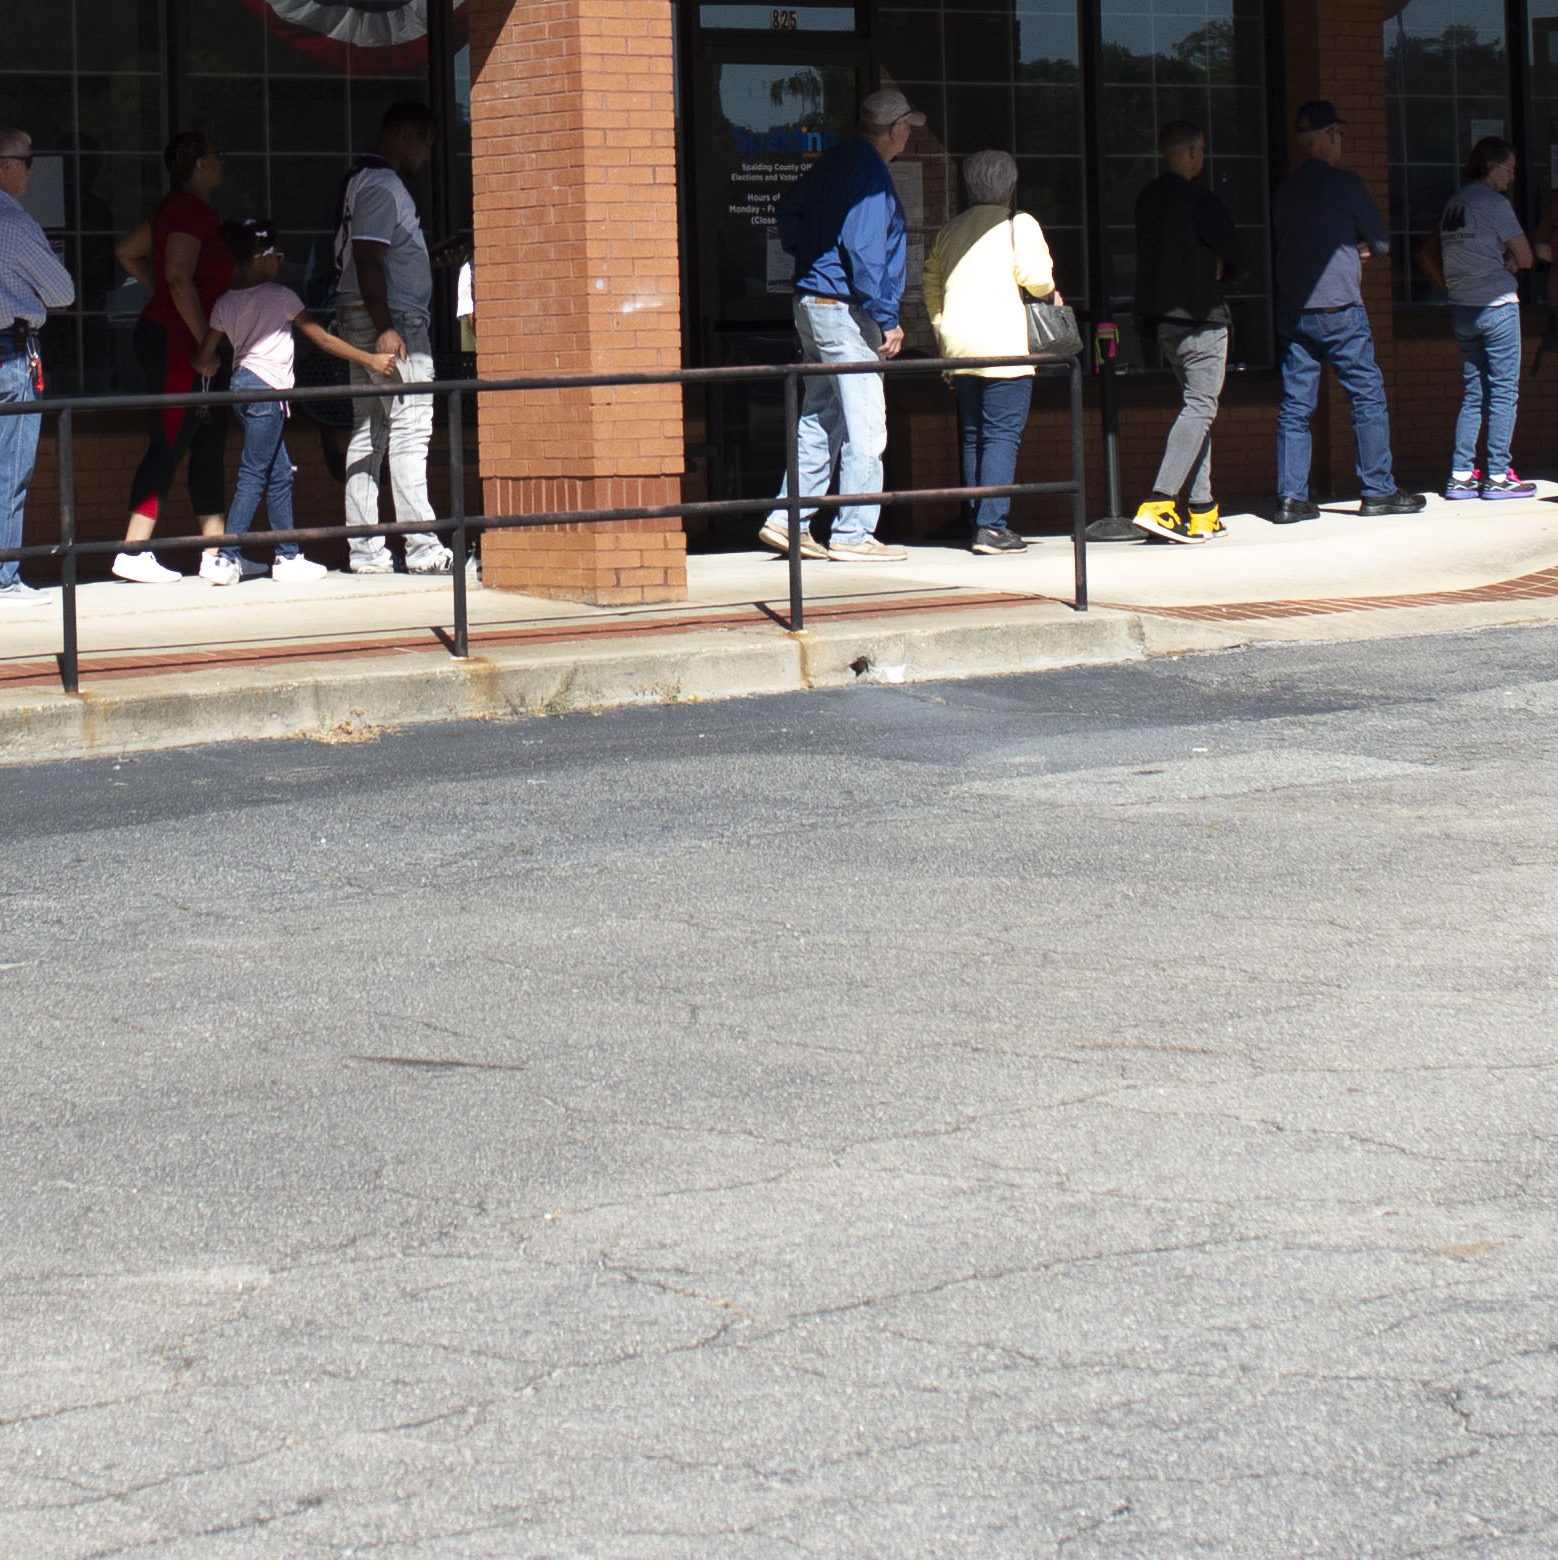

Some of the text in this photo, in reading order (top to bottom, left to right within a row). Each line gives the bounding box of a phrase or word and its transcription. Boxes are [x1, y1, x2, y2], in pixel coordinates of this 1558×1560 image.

[773, 9, 797, 30] 825
[742, 163, 773, 172] Spalding
[774, 163, 799, 172] County
[731, 173, 763, 181] Elections
[764, 173, 778, 181] and
[779, 173, 799, 181] Voter
[747, 193, 771, 202] Hours
[729, 205, 760, 214] Monday
